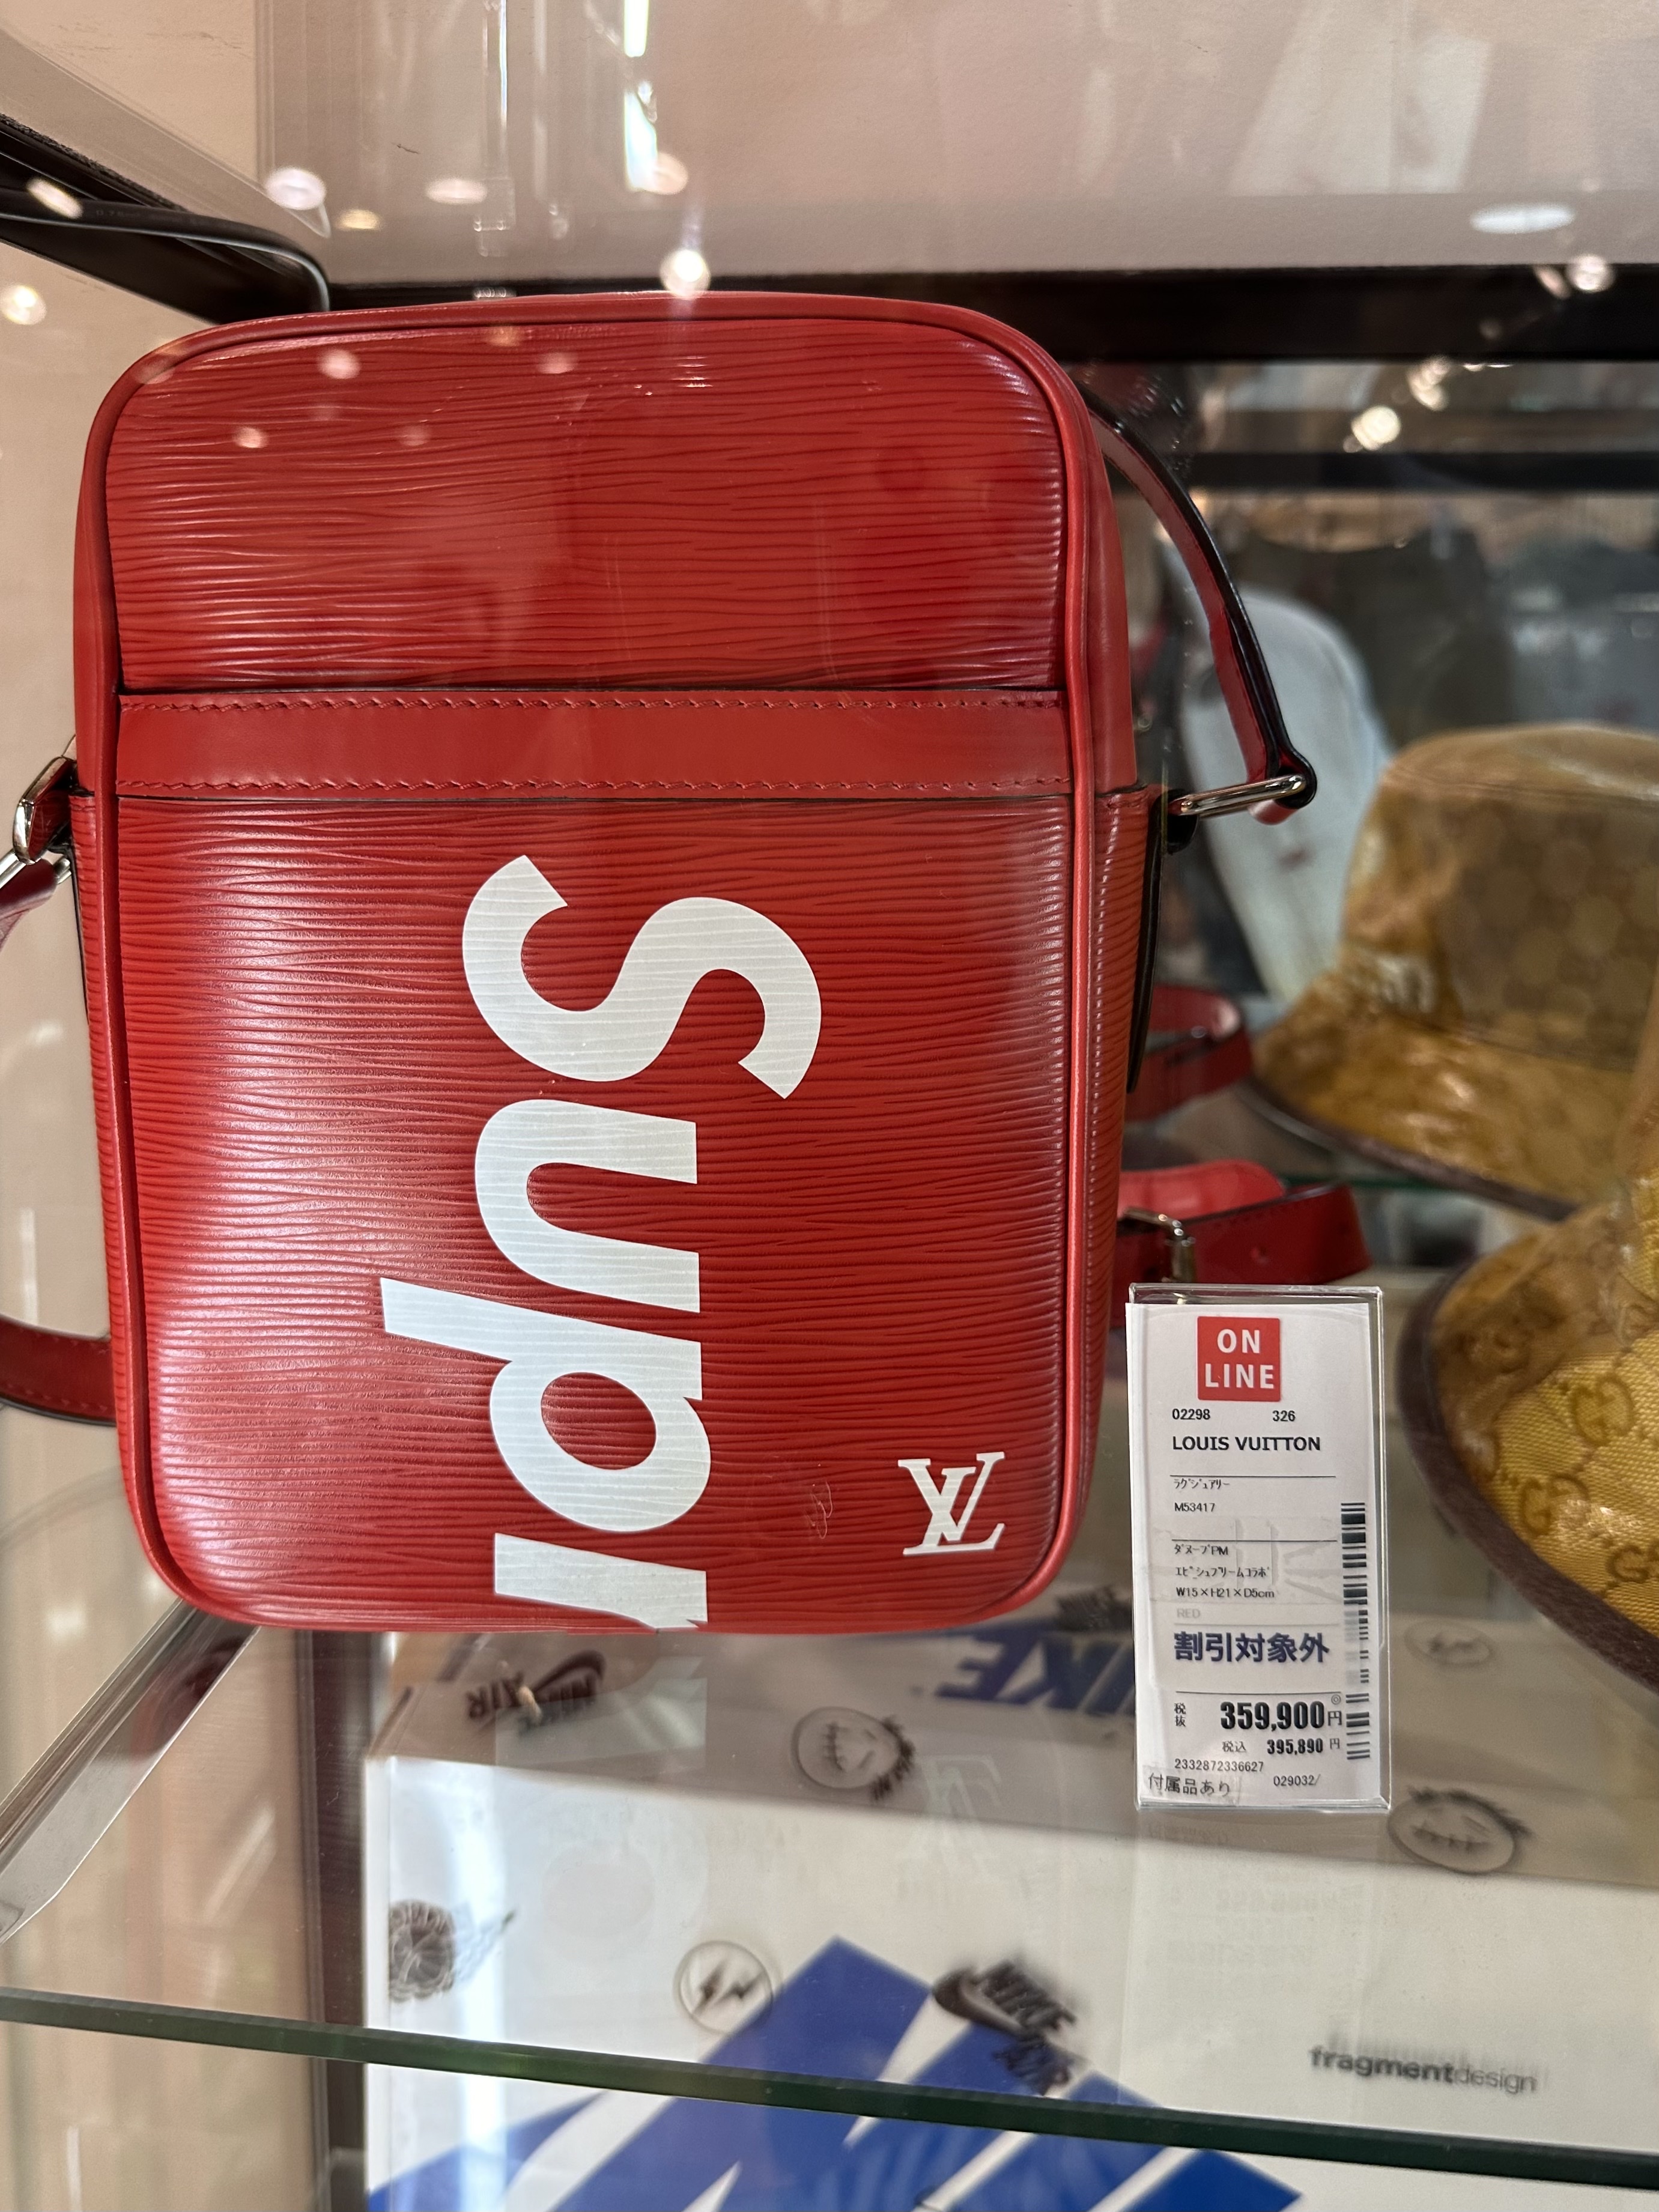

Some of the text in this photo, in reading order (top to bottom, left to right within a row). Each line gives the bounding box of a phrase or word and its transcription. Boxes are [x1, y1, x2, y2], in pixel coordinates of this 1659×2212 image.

[1217, 1329, 1260, 1354] ON
[1204, 1363, 1275, 1389] LINE
[1171, 1408, 1211, 1420] 02298
[1272, 1410, 1296, 1422] 326
[1172, 1435, 1321, 1451] LOUIS VUITTON
[898, 1452, 1005, 1556] LV
[1174, 1502, 1216, 1512] M53417
[1176, 1608, 1201, 1619] RED
[1173, 1631, 1330, 1663] 割引対象外
[1221, 1740, 1247, 1753] 税込
[1174, 1758, 1264, 1772] 2332872336627
[1148, 1772, 1230, 1798] 付属品あり
